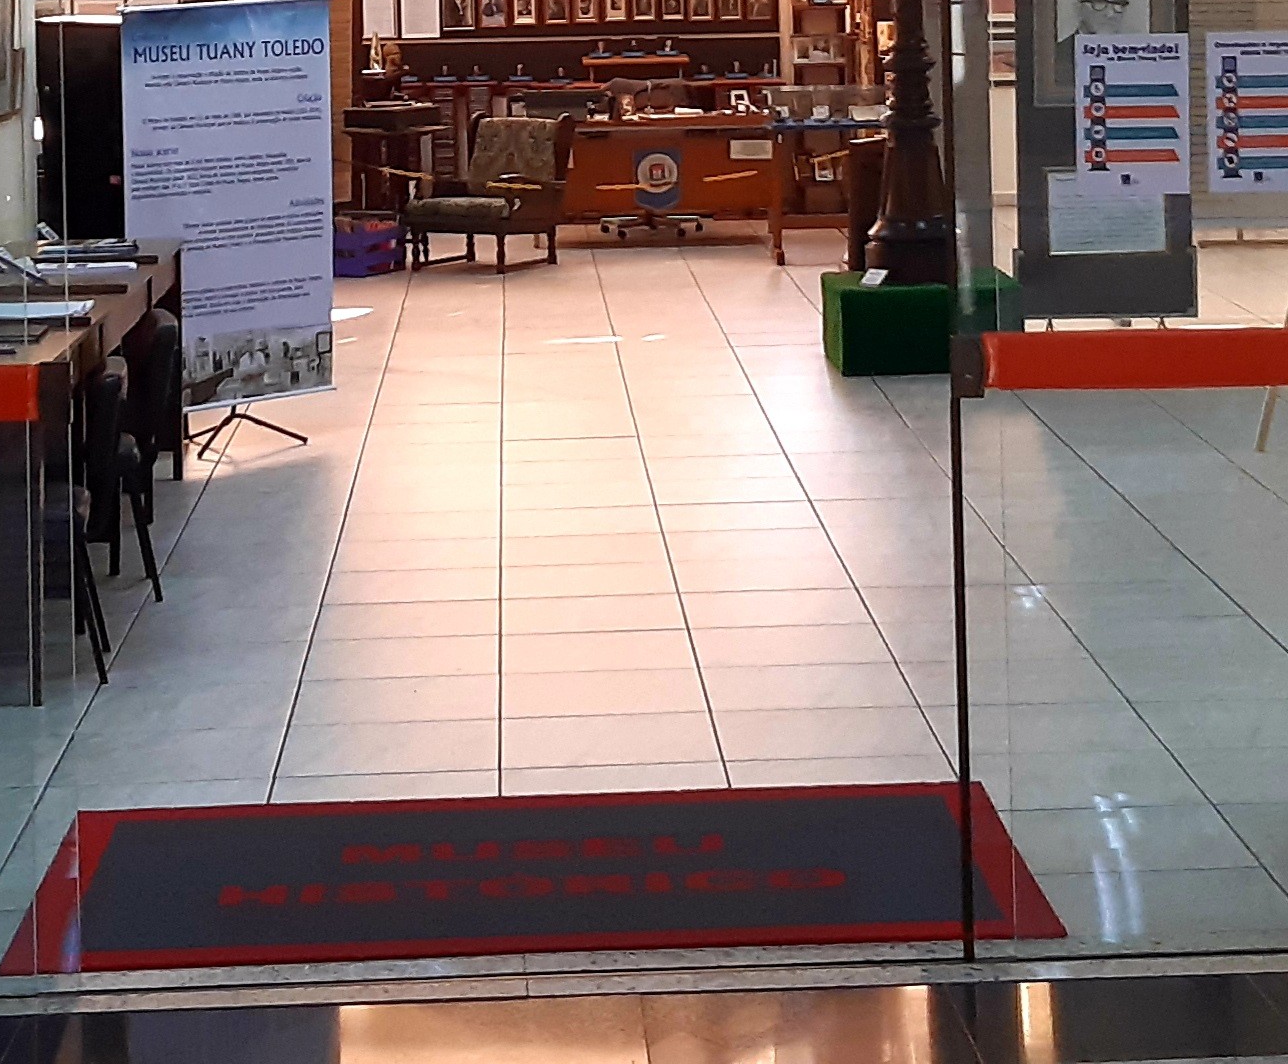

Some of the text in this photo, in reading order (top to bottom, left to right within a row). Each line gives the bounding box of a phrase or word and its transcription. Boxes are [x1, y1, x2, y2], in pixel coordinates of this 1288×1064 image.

[133, 38, 325, 63] MUSEU TUANY TOLEDO
[341, 833, 724, 863] MUSEU
